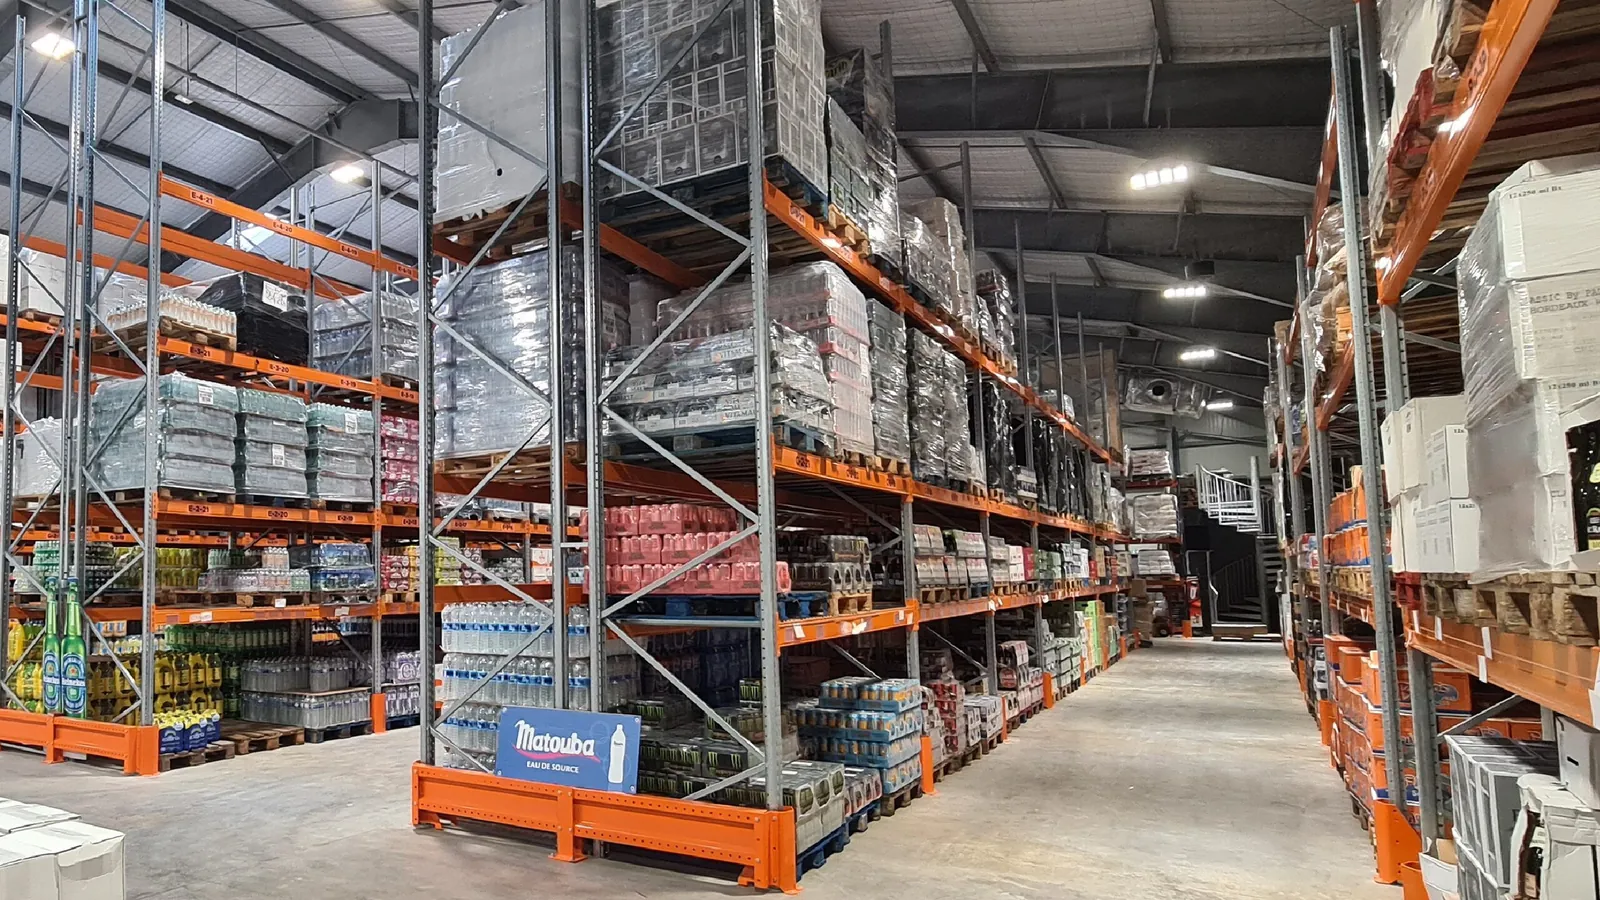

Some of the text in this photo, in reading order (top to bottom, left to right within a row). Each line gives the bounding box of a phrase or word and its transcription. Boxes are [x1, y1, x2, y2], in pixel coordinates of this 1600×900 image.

[191, 191, 213, 204] E-4-21
[272, 222, 293, 233] E-4-20
[1530, 300, 1589, 314] BORDEAUX
[190, 346, 211, 357] E-3-21
[269, 364, 290, 373] E-3-20
[188, 504, 210, 513] E-2-21
[267, 510, 288, 518] E-2-20
[514, 719, 595, 756] Matouba
[526, 760, 579, 774] EAU DE SOURCE
